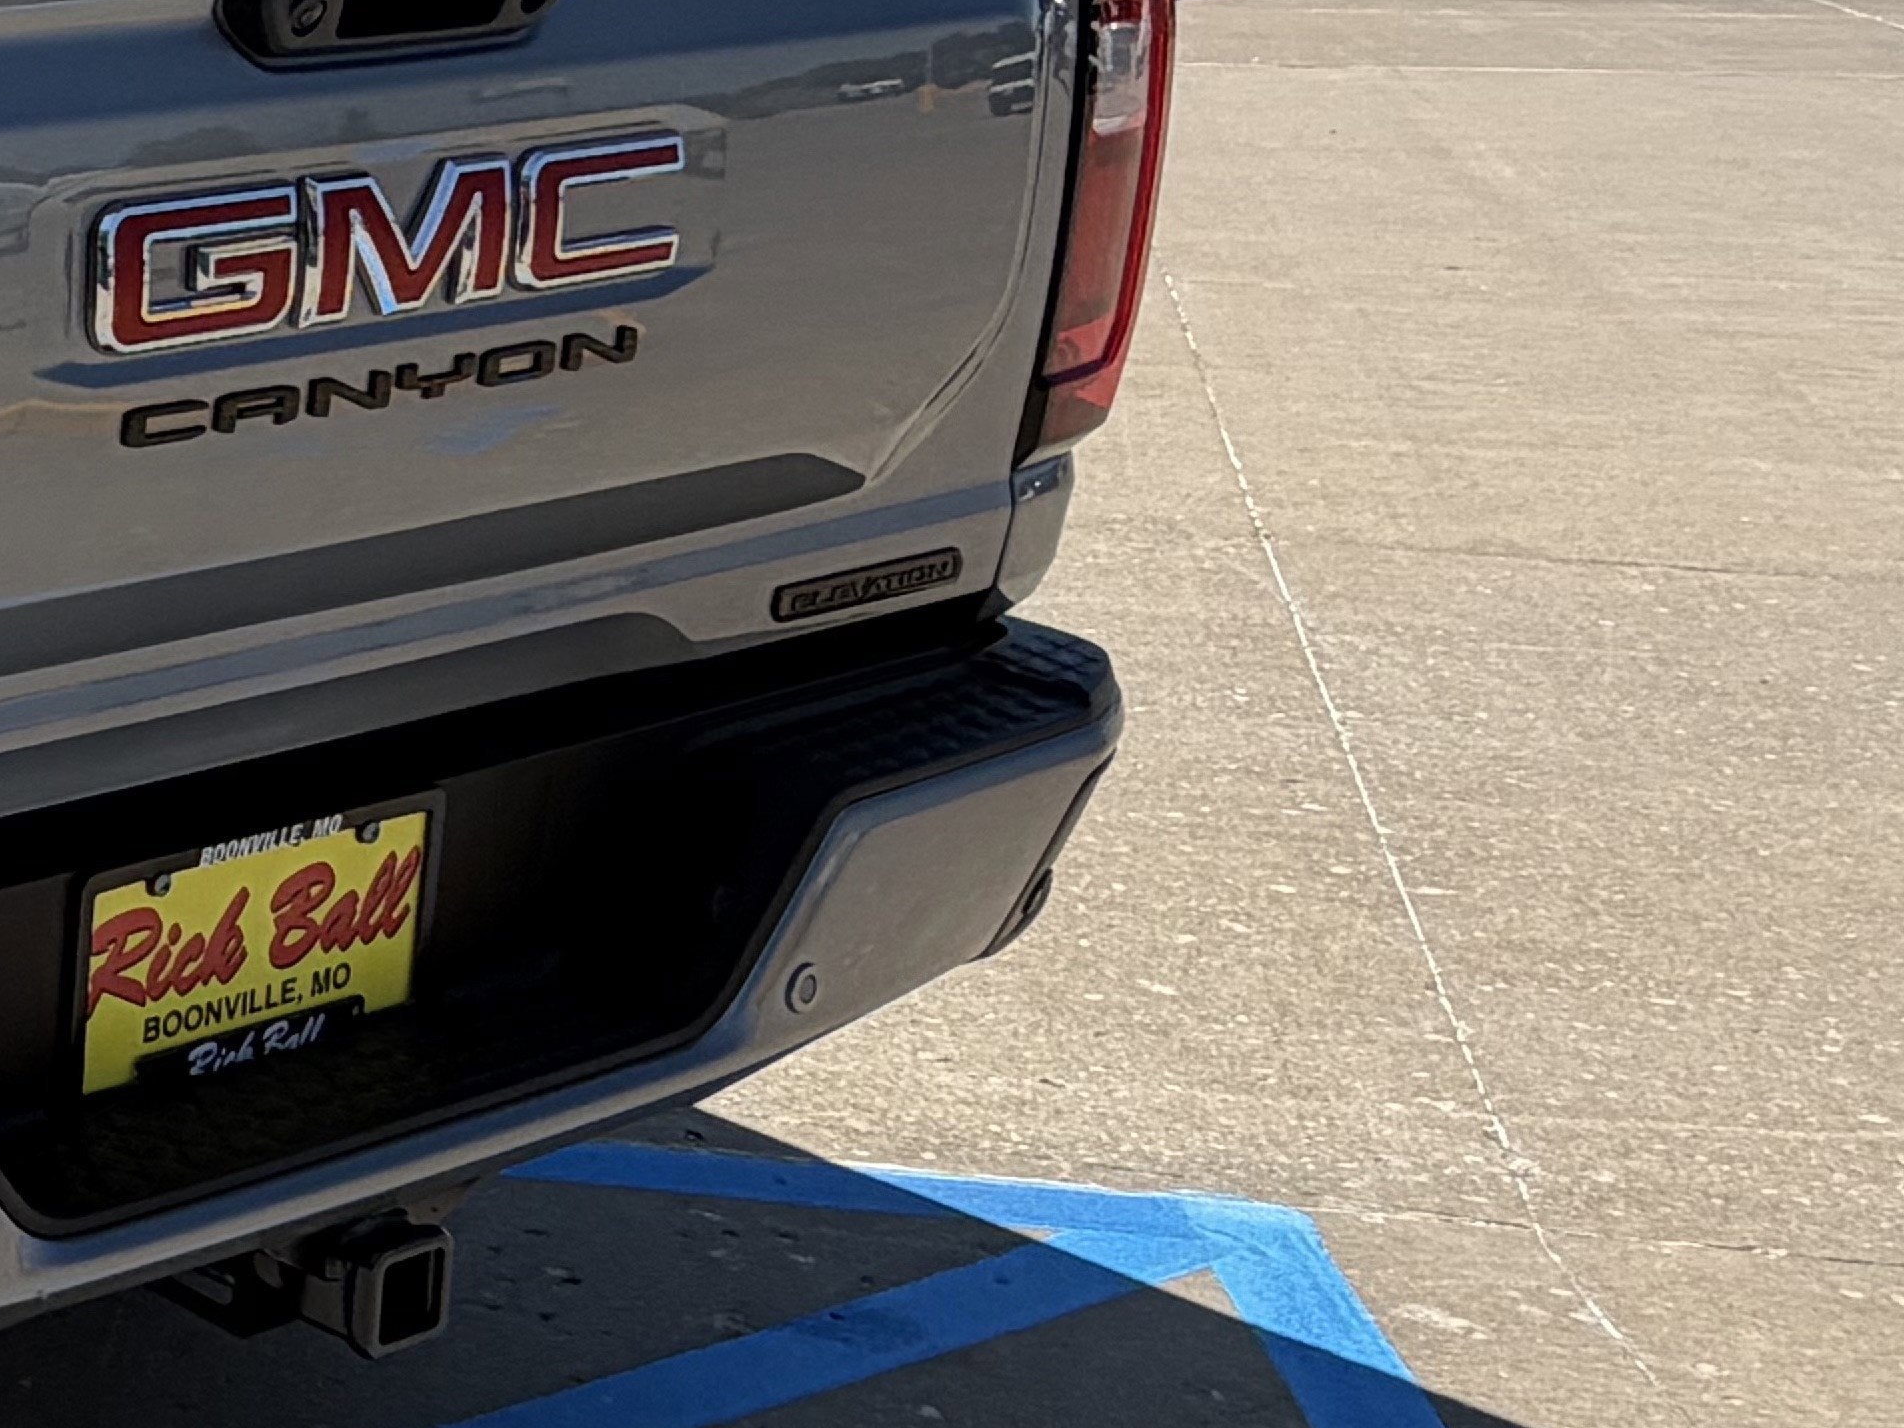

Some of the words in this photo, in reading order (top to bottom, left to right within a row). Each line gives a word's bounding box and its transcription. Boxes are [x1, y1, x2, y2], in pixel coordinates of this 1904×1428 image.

[88, 128, 685, 354] GMC
[120, 324, 639, 448] CANYON
[312, 813, 344, 839] MO
[87, 886, 250, 1021] Rick
[268, 844, 422, 970] Ball
[142, 977, 304, 1044] BOONVILLE,
[310, 962, 352, 997] MO
